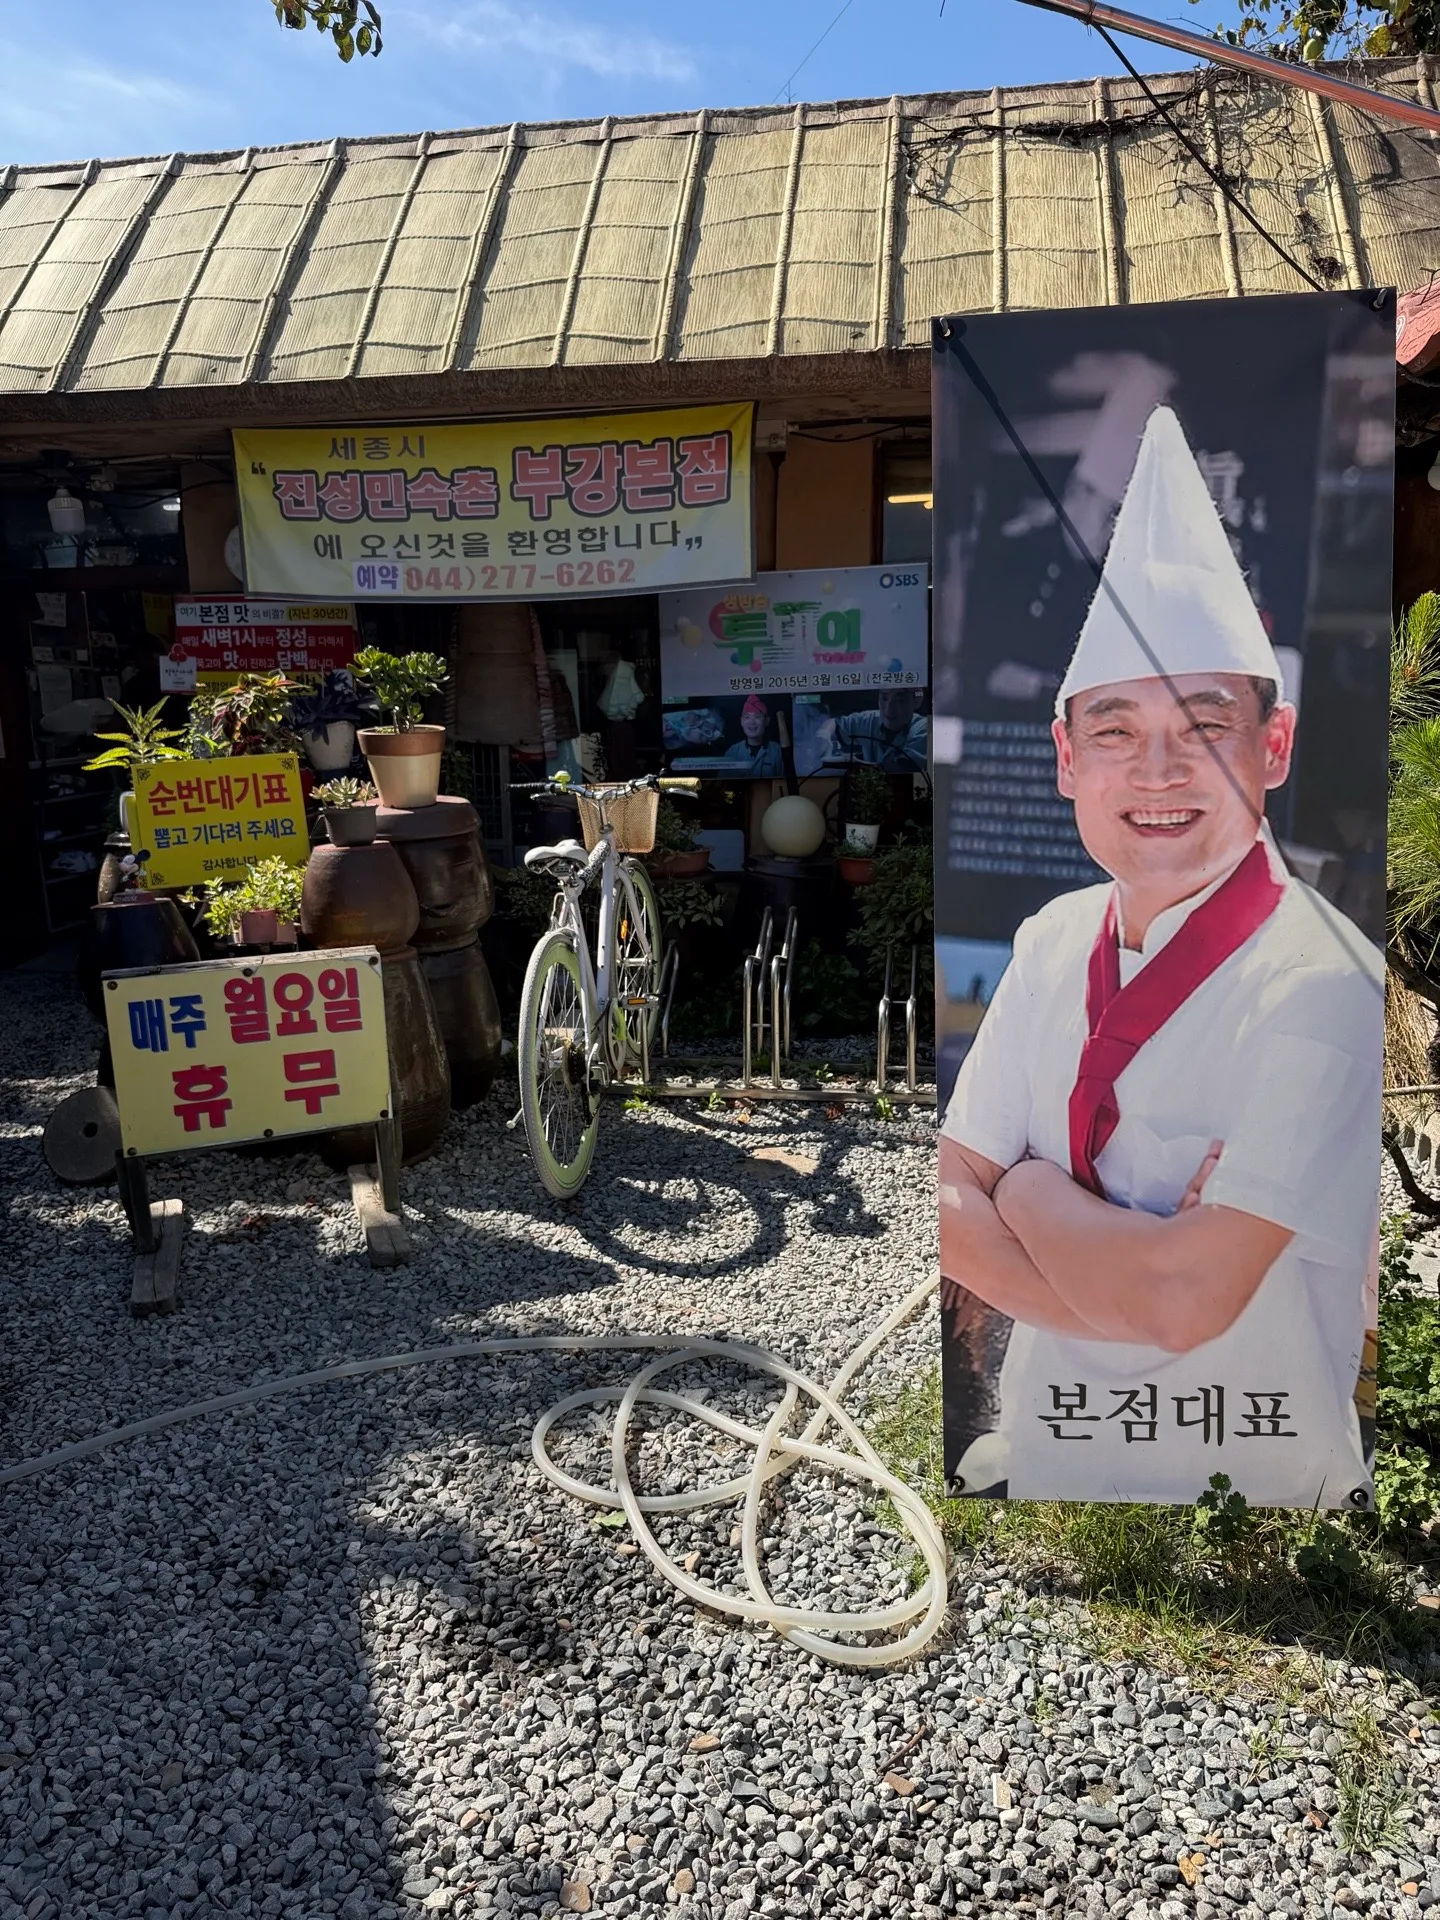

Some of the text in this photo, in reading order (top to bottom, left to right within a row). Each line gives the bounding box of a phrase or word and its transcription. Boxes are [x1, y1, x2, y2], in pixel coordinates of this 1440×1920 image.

[328, 434, 426, 461] 세종시
[510, 429, 735, 520] 부강본점
[313, 534, 344, 559] 에
[361, 531, 492, 559] 오신것을
[355, 558, 636, 592] 예약 044)277-6262
[895, 574, 920, 586] SBS
[180, 604, 348, 624] 여기 본점 맛 의 비결? (지난 30년간)
[181, 635, 199, 647] 매일
[317, 635, 344, 648] 다해서
[713, 600, 861, 666] 투이
[223, 650, 248, 670] 맛이
[249, 657, 275, 669] 진하고
[730, 671, 920, 690] 방영일 2015년 3월 16일 (전국방송)
[148, 773, 292, 816] 순번대기표
[154, 818, 297, 849] 뽑고 기다려 주세요
[202, 855, 258, 871] 감사합니다
[128, 967, 363, 1053] 매주 월요일
[1037, 1382, 1298, 1447] 본점대표
